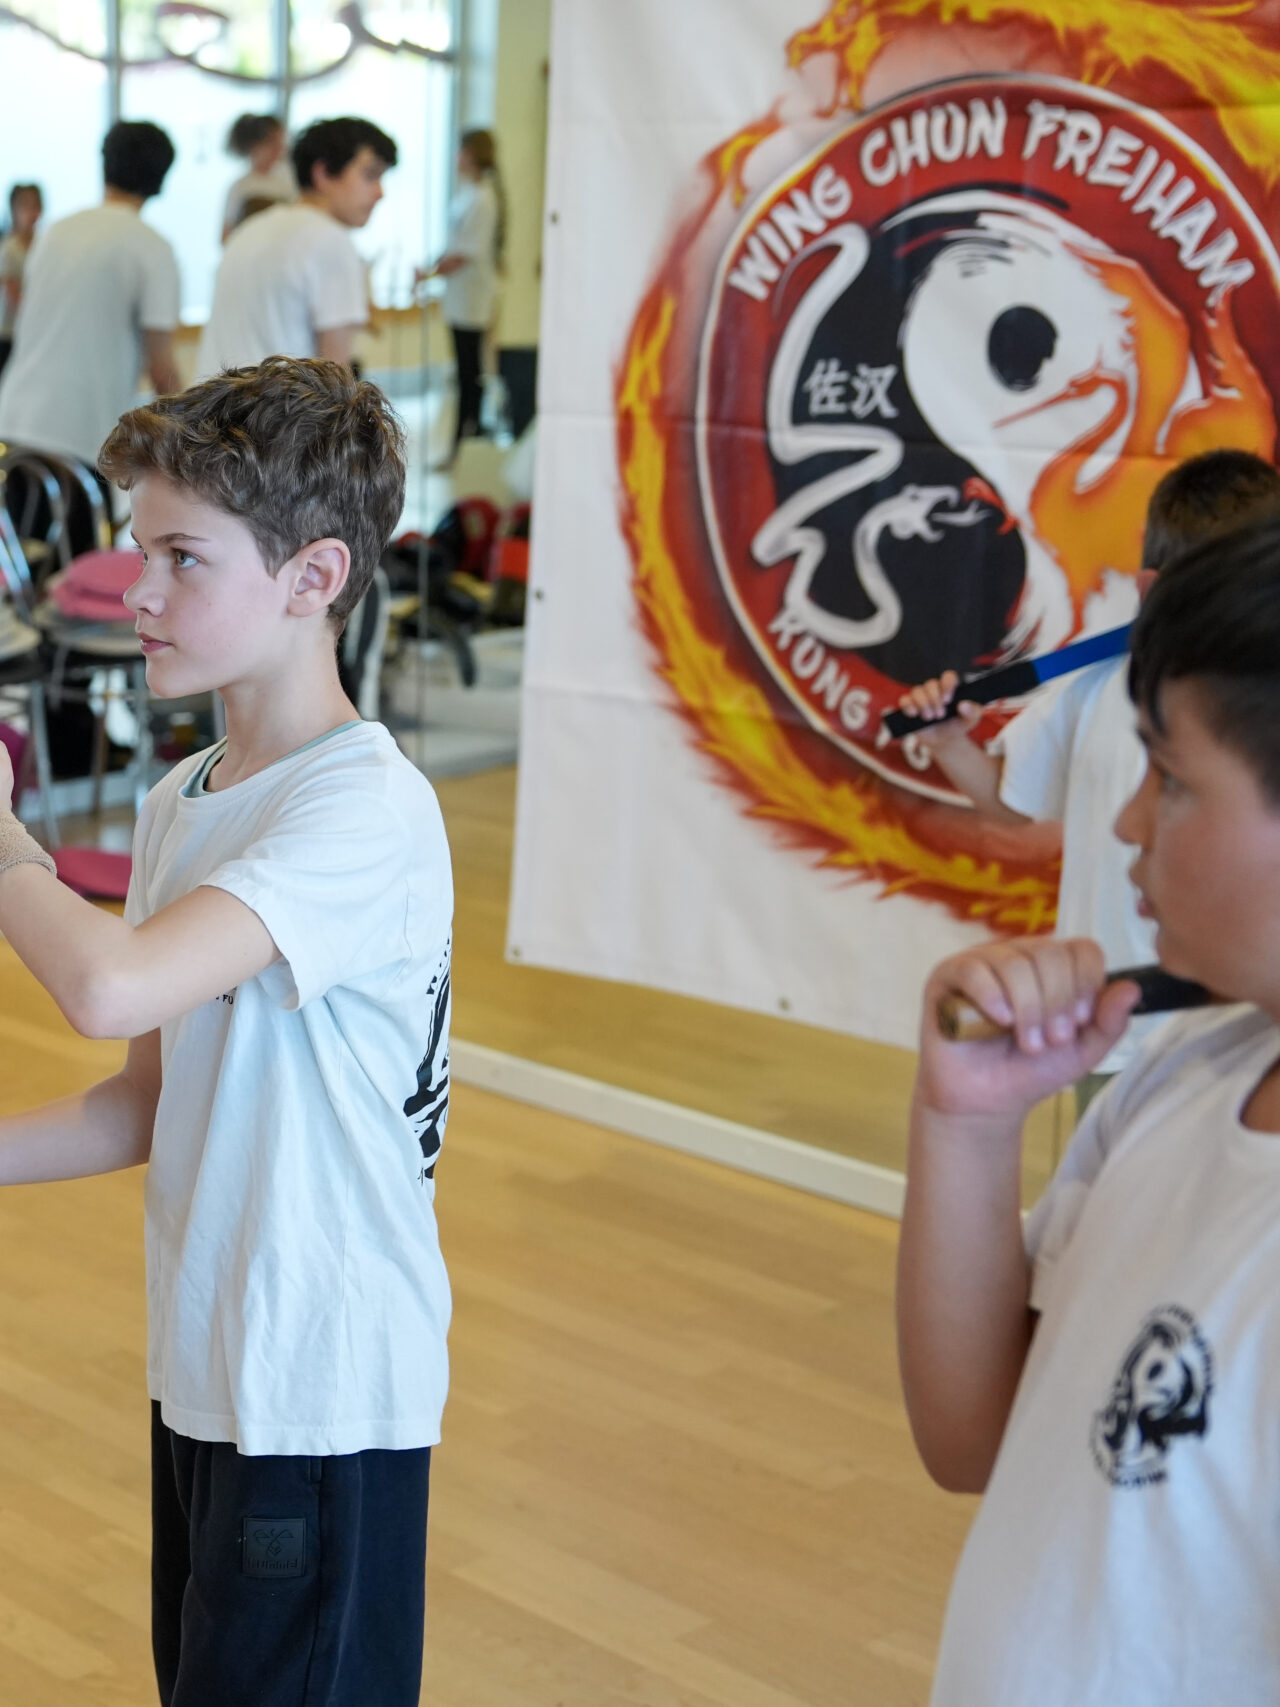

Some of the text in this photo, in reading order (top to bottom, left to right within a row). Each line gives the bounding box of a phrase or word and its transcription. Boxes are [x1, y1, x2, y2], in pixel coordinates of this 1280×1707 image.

[727, 98, 1255, 304] WING CHUN FREIHAM
